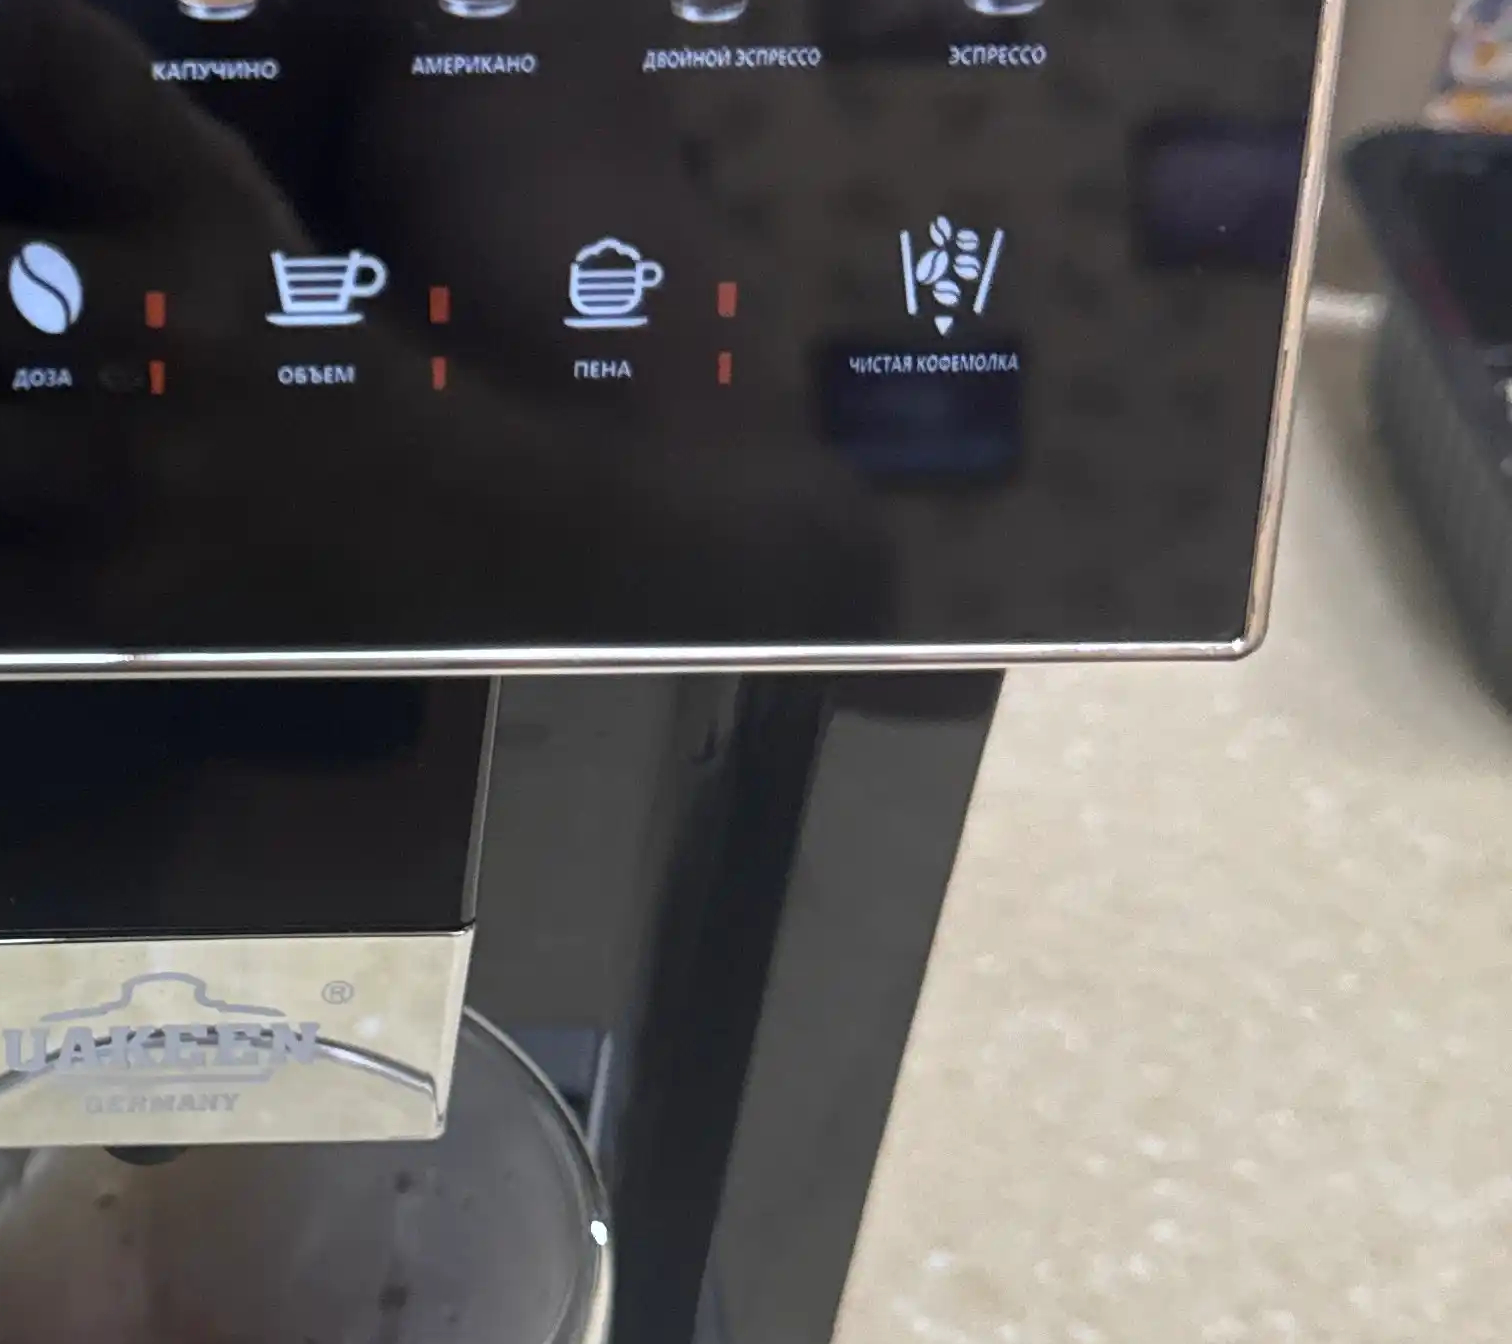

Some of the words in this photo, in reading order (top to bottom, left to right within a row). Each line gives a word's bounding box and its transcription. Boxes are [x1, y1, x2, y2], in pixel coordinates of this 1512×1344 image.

[411, 53, 537, 75] АМЕРИКАНО
[642, 45, 732, 73] ДВОЙНОЙ
[735, 44, 822, 68] ЭСПРЕССО
[948, 43, 1047, 66] ЭСПРЕССО
[151, 58, 280, 81] КАПУЧИНО
[277, 363, 356, 385] ОБЪЕМ
[573, 359, 632, 380] ПЕНА
[848, 354, 913, 374] ЧИСТАЯ
[916, 351, 1020, 373] КОФЕМОЛКА
[12, 366, 73, 391] ДОЗА
[1, 1021, 321, 1072] UAKEEN
[85, 1093, 240, 1114] GERMANY
